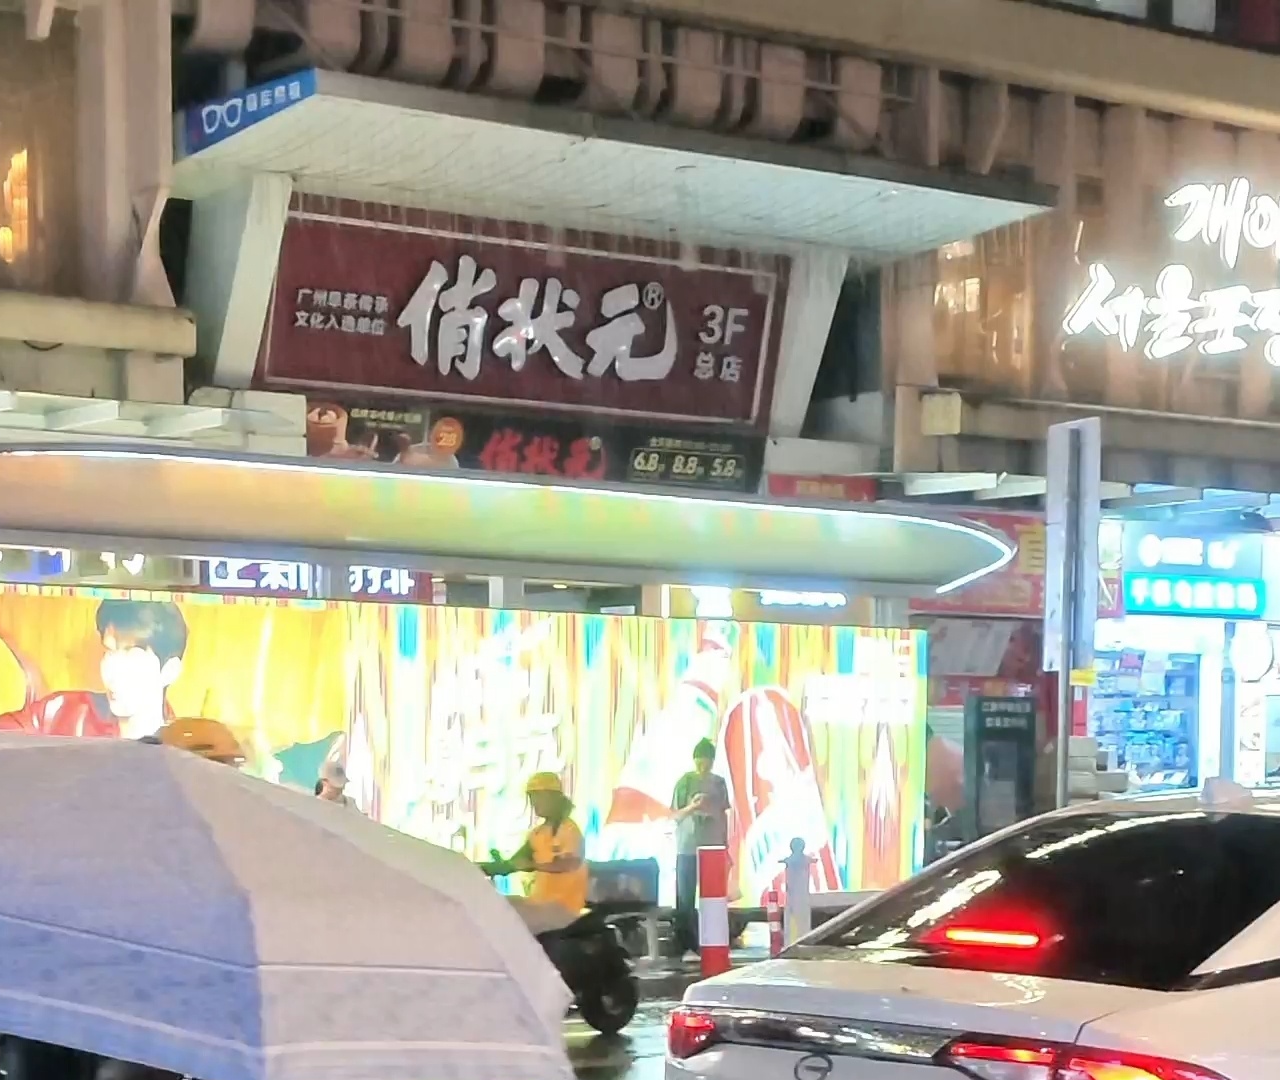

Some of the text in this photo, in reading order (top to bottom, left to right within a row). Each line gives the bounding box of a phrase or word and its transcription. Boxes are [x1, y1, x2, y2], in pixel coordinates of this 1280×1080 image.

[397, 254, 678, 381] 俏状元
[698, 304, 750, 345] 3F
[693, 352, 743, 383] 总店
